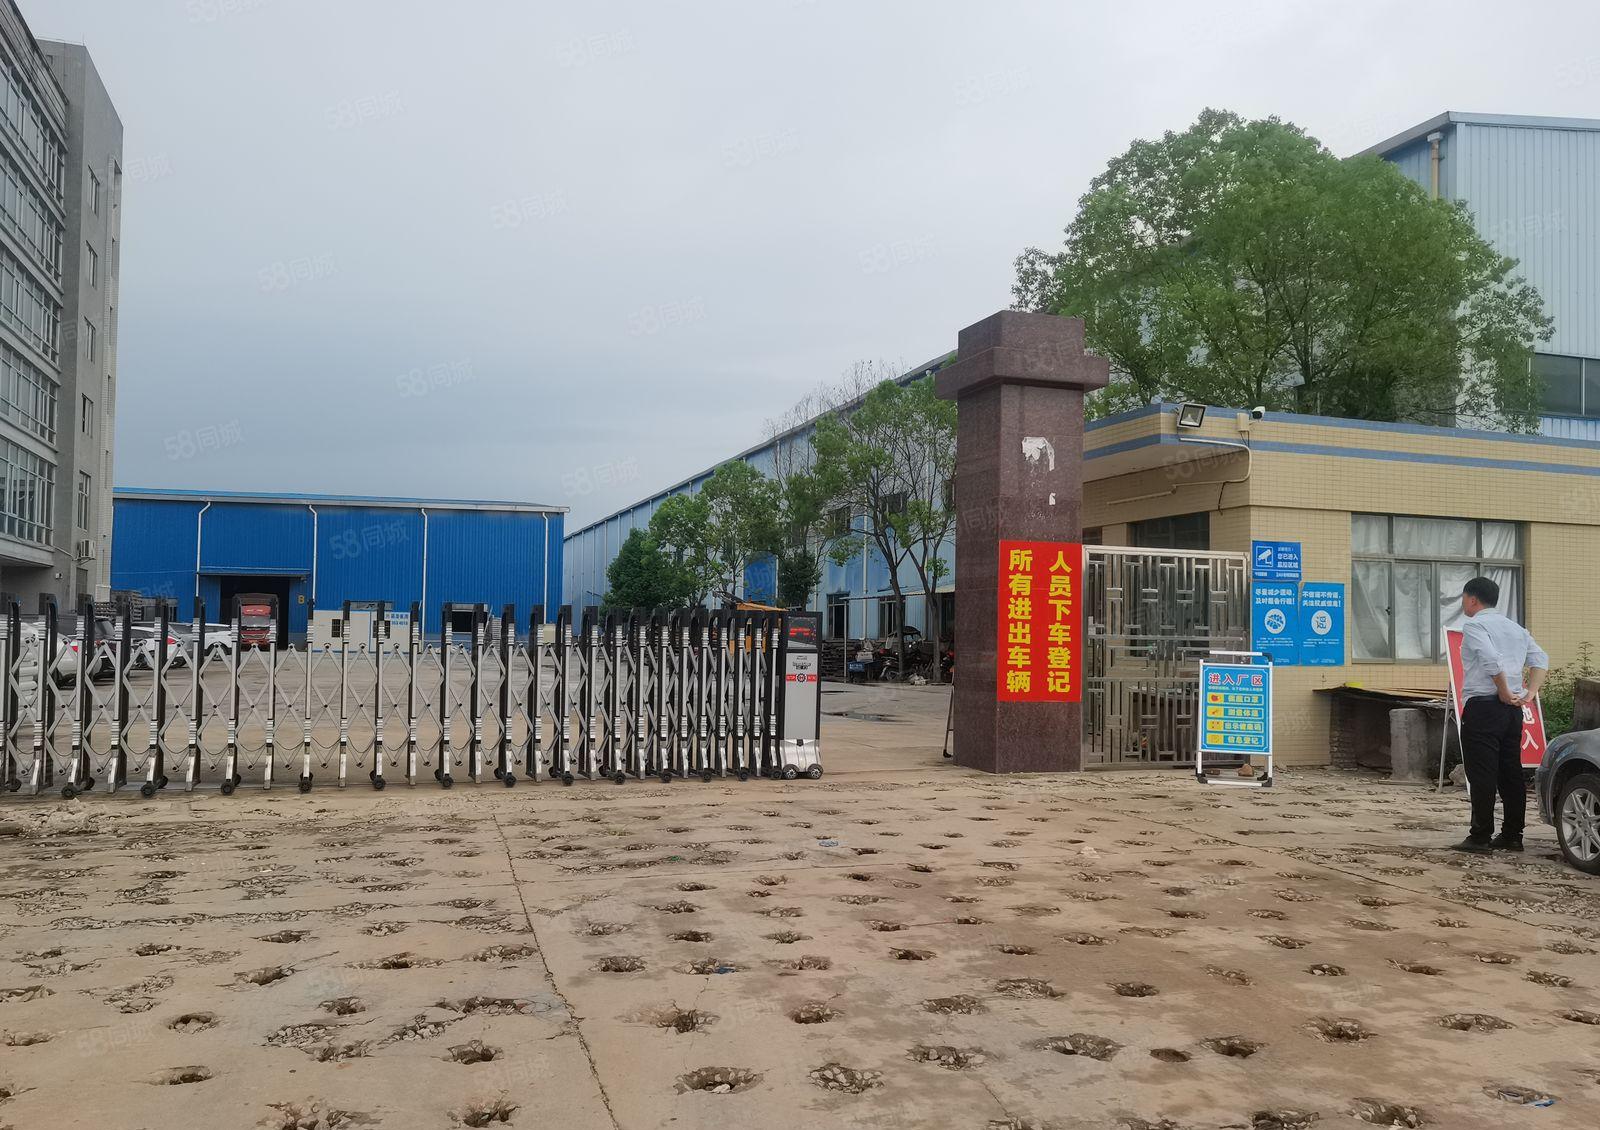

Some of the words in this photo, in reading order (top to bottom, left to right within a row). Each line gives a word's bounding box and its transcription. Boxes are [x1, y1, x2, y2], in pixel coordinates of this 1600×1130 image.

[1006, 549, 1033, 693] 所有进出车辆
[1047, 550, 1072, 693] 人员下车登记
[1208, 672, 1264, 687] 进入厂区
